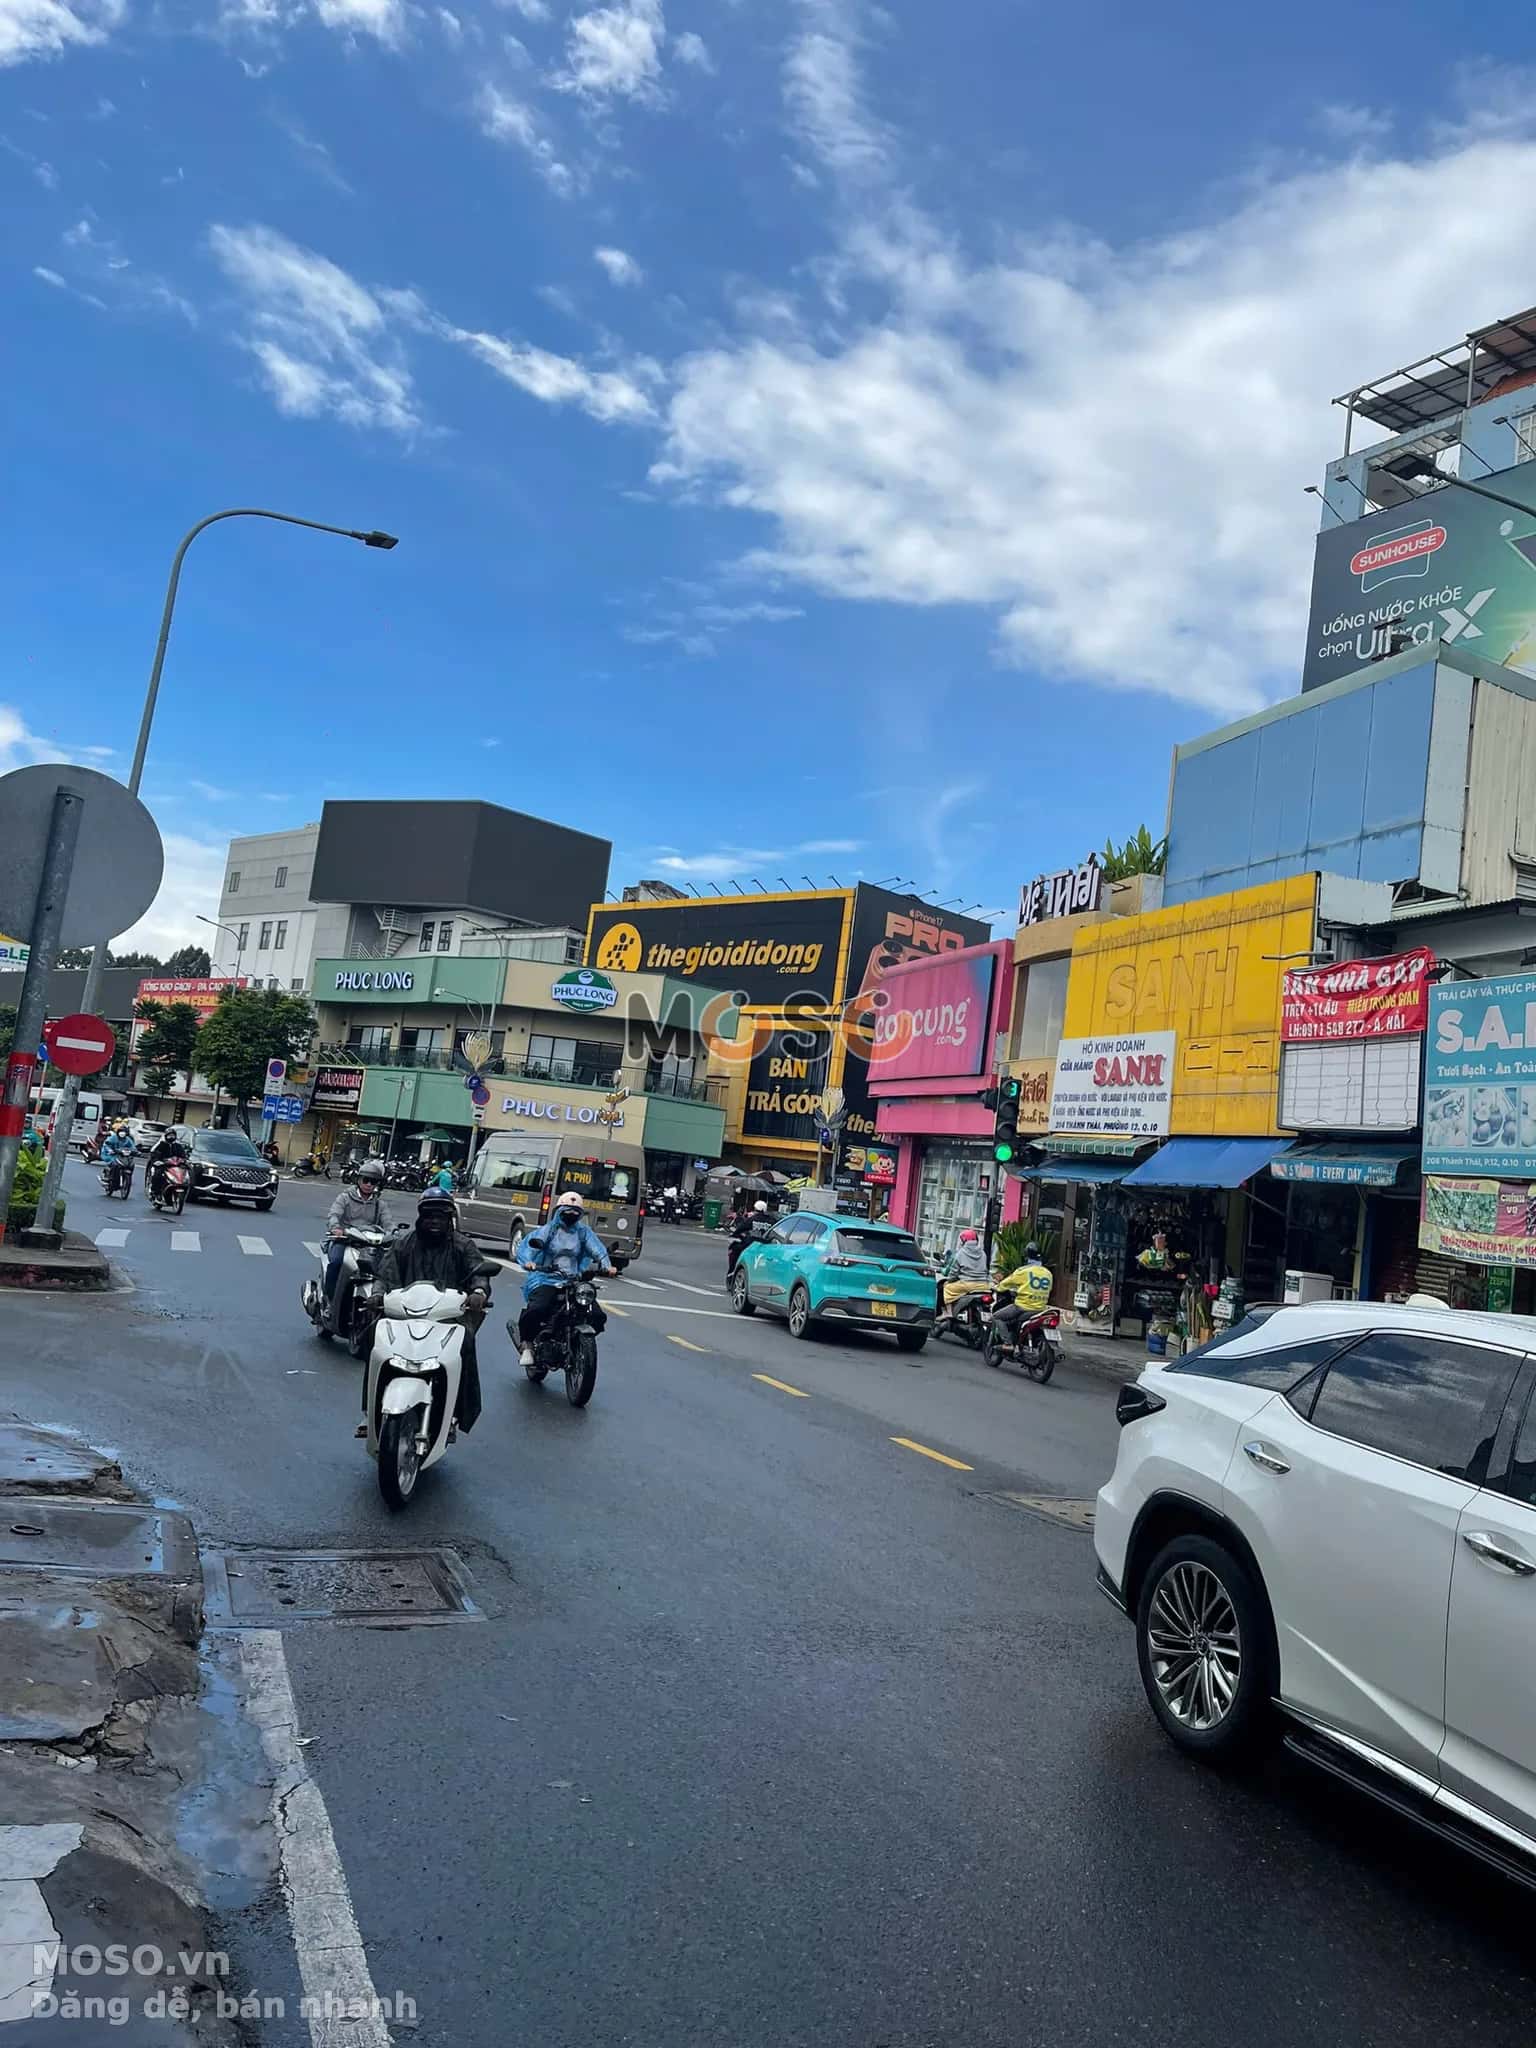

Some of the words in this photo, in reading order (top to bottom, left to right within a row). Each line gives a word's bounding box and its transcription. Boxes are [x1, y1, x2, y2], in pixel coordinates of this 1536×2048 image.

[1358, 532, 1438, 569] SUNHOUSE
[1322, 610, 1365, 637] UỐNG
[1368, 599, 1415, 625] NƯỚC
[1418, 584, 1463, 611] KHỎE
[1318, 638, 1353, 659] chọn
[885, 911, 965, 953] PRO
[646, 939, 823, 975] thegioididong
[335, 971, 371, 990] PHUC
[374, 971, 413, 990] LONG
[554, 986, 583, 997] PHUC
[584, 988, 614, 1002] LONG
[1094, 1042, 1114, 1054] KINH
[1116, 1039, 1145, 1052] DOANH
[1093, 1054, 1165, 1087] SANH
[502, 1097, 560, 1120] PHUC
[748, 1085, 781, 1113] TRẢ
[783, 1088, 822, 1115] GÓP
[1322, 1166, 1345, 1180] EVERY
[1347, 1167, 1362, 1181] DAY
[1030, 1272, 1049, 1291] be
